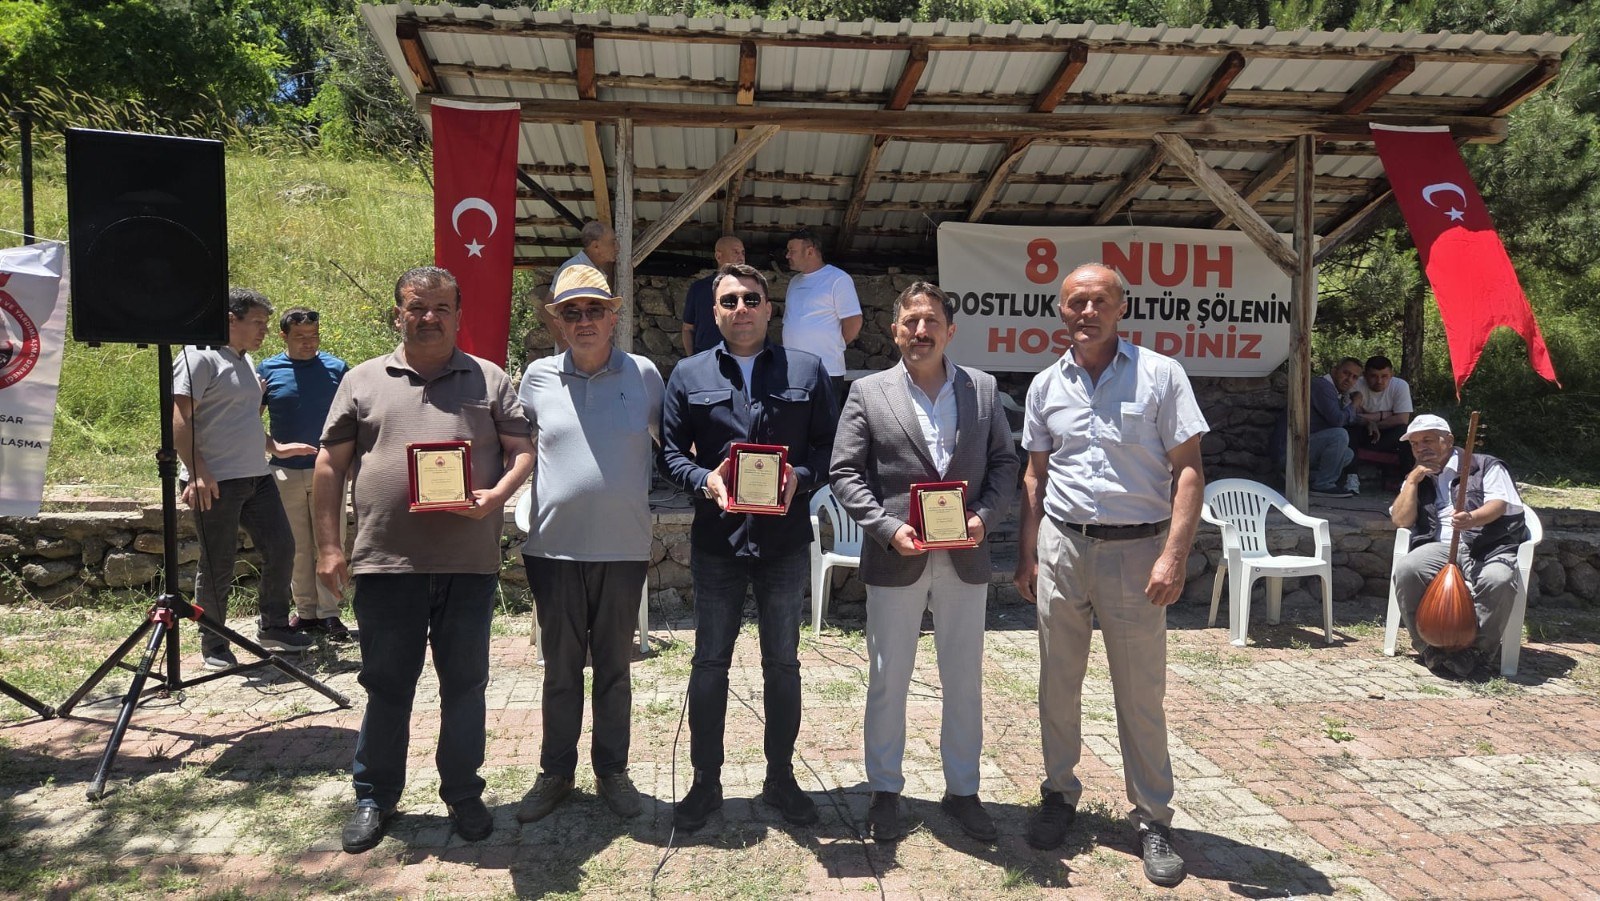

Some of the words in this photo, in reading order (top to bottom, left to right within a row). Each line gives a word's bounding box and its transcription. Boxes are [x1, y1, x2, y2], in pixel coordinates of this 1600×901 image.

[1025, 238, 1059, 285] 8
[1102, 241, 1234, 289] NUH
[944, 291, 1057, 318] DOSTLUK
[1122, 290, 1190, 321] ÜLTÜR
[1197, 292, 1291, 329] ŞÖLENİN
